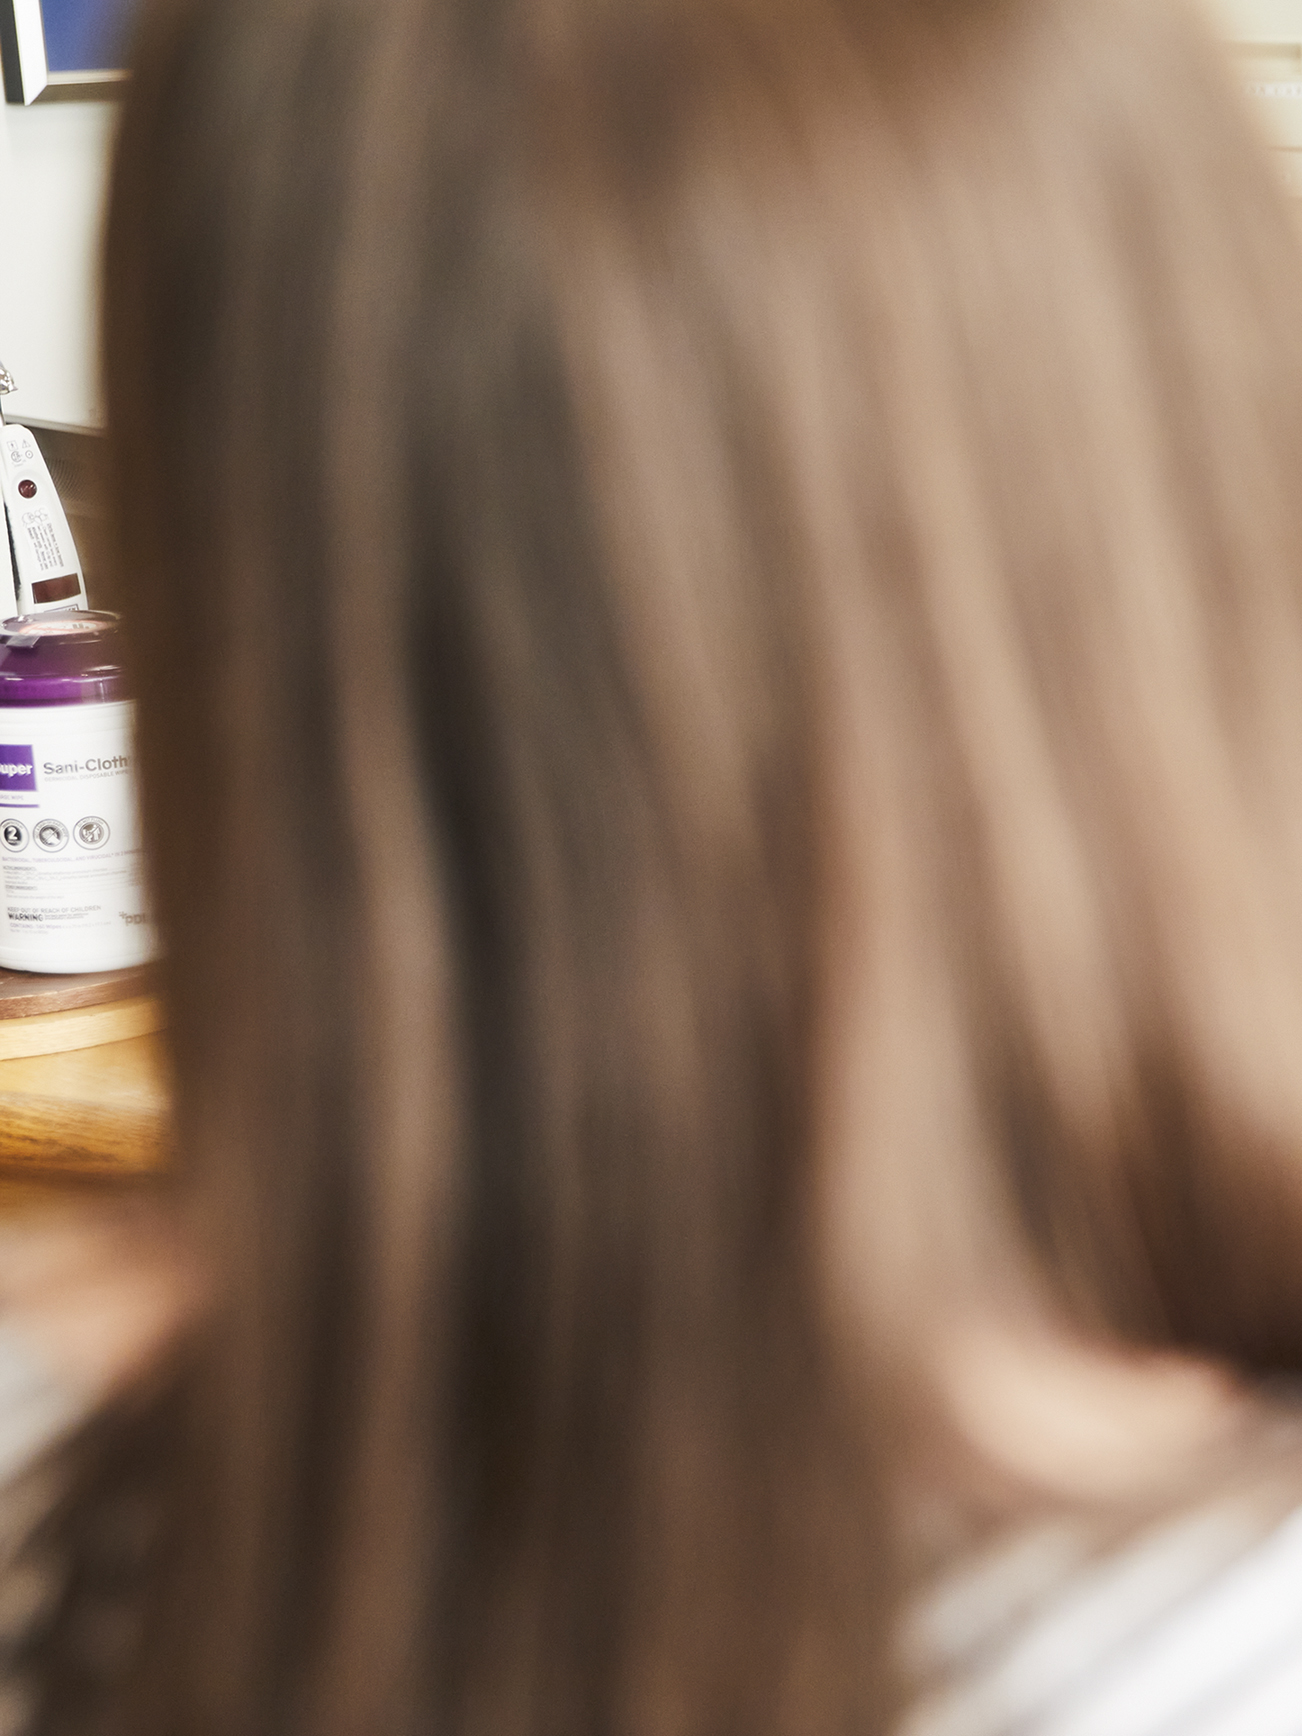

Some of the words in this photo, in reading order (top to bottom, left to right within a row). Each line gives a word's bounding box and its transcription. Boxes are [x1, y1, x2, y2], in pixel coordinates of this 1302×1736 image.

[0, 763, 33, 778] uper
[43, 755, 128, 776] Sani-Cloth
[7, 826, 18, 840] 2
[8, 912, 44, 922] WARNING
